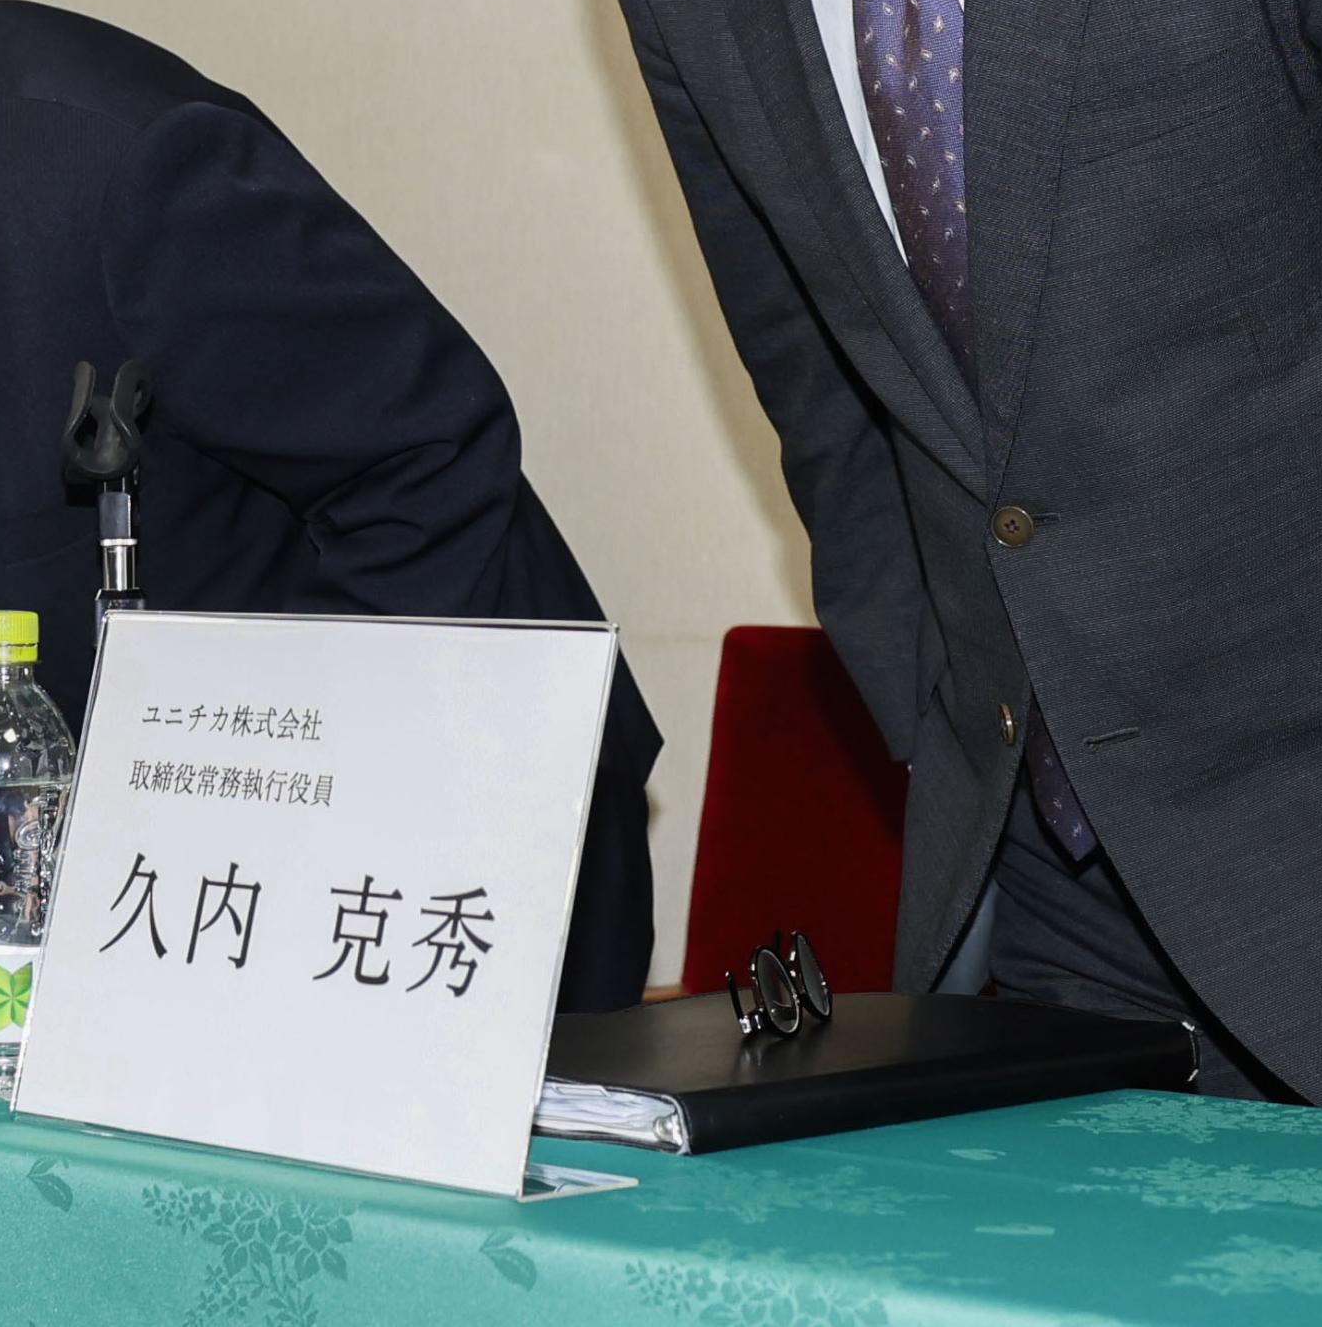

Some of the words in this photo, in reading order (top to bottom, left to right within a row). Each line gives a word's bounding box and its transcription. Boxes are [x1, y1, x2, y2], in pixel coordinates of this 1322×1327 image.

[142, 704, 323, 741] ユニチカ株式会社
[129, 760, 334, 807] 取締役常務執行役員
[99, 852, 263, 969] 久内
[312, 874, 495, 998] 克秀
